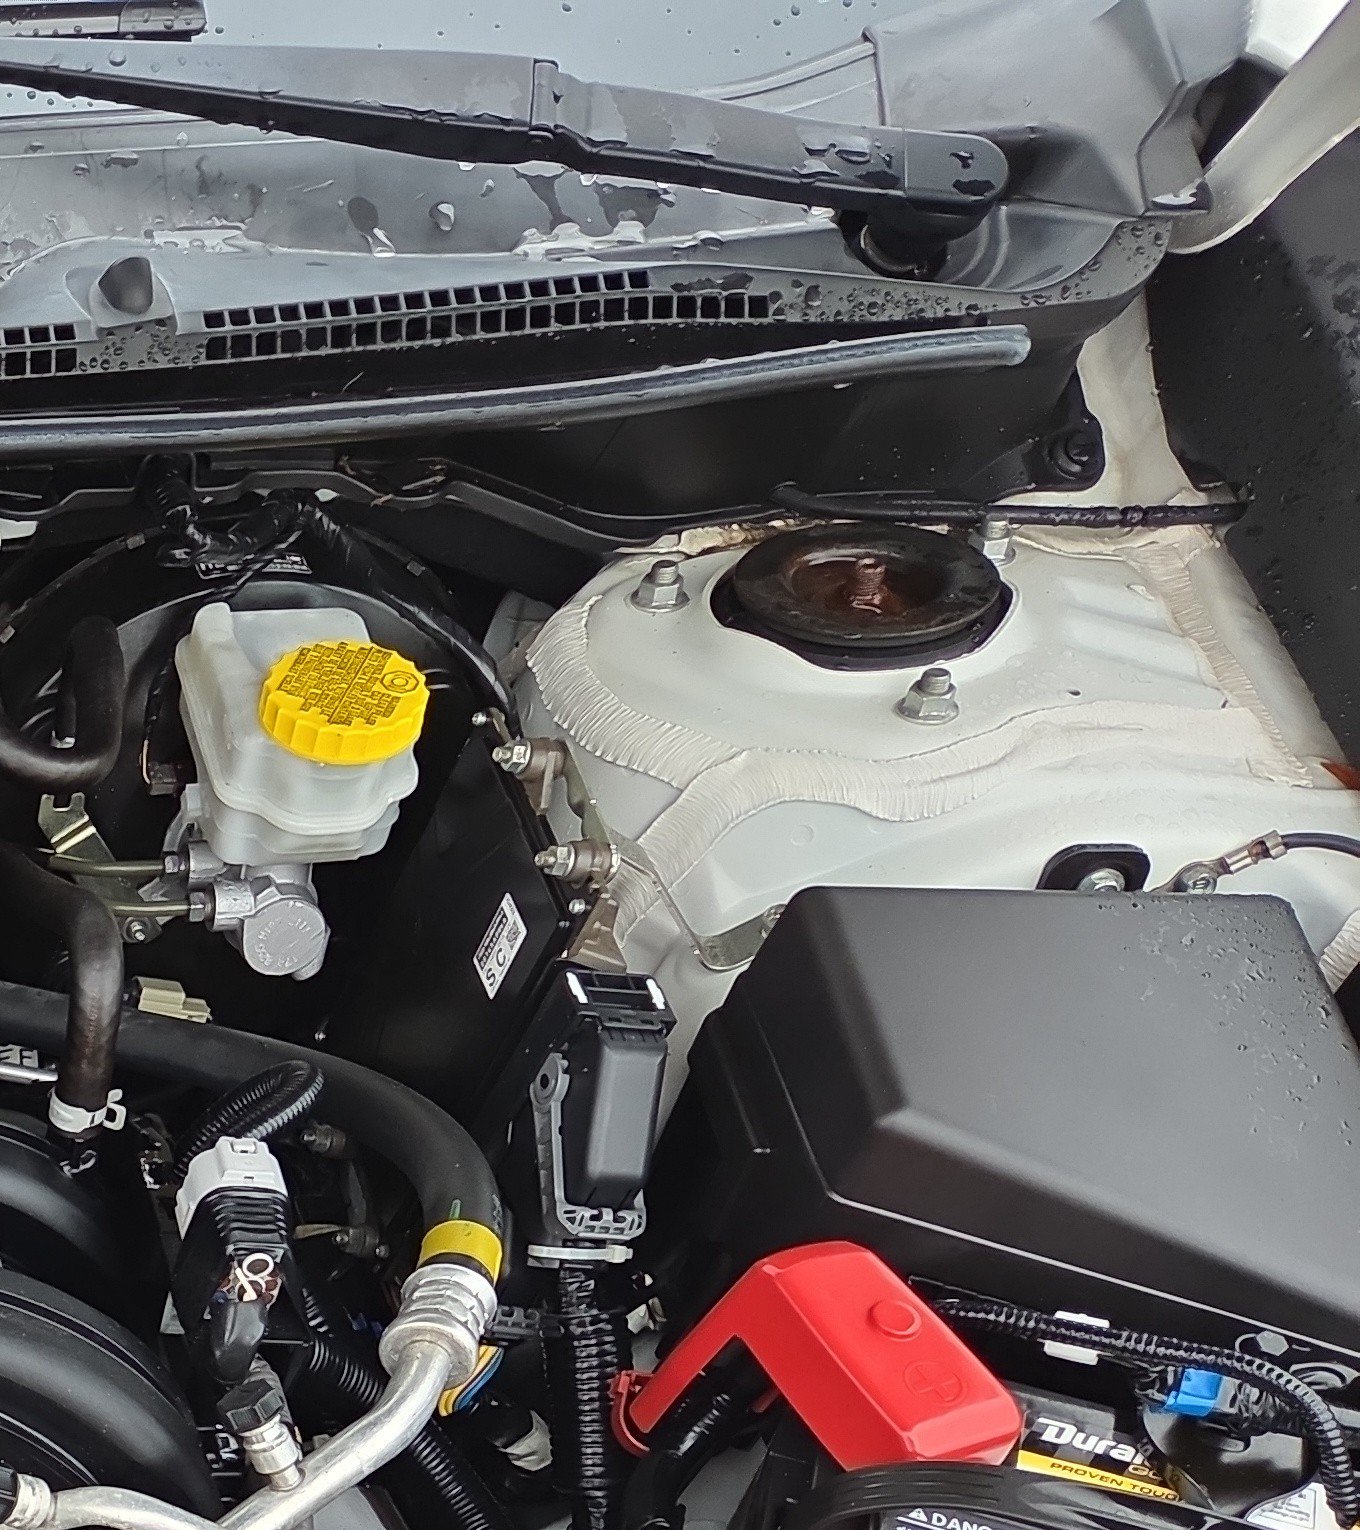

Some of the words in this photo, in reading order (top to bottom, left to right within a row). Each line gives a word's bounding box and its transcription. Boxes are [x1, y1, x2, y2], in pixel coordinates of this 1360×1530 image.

[1037, 1417, 1152, 1467] Dural
[1050, 1462, 1124, 1487] PROVEN
[1129, 1483, 1179, 1502] TOUG
